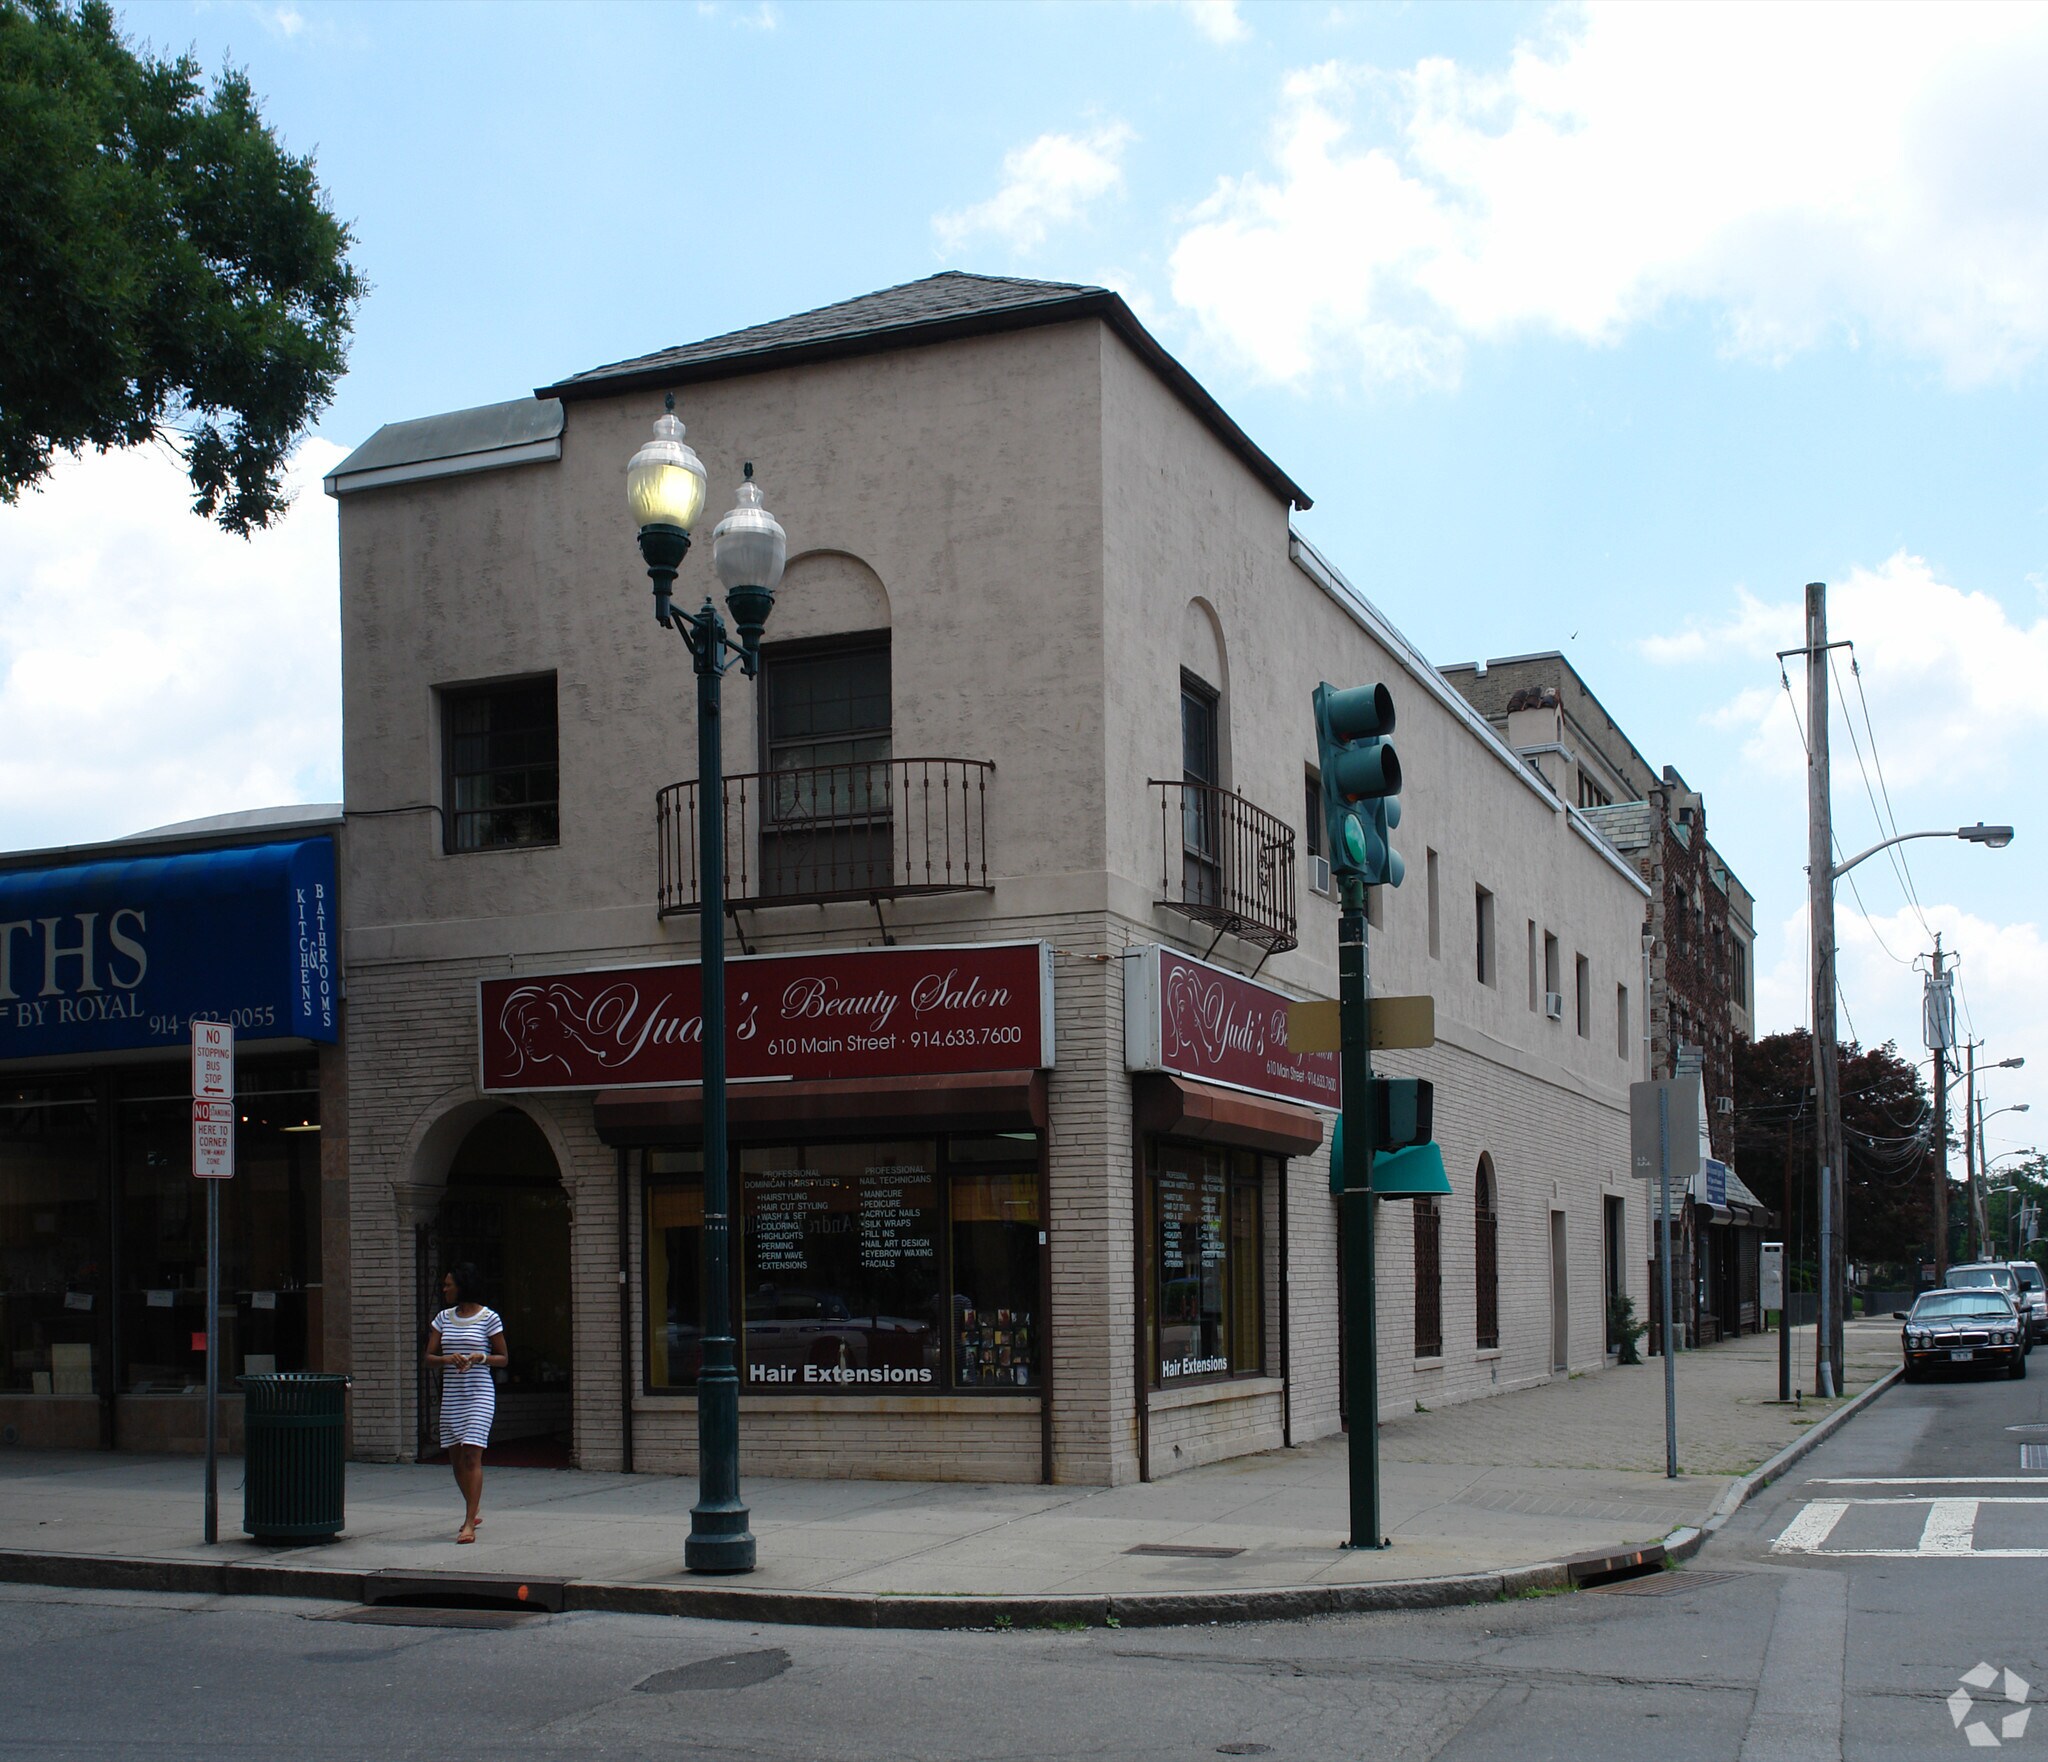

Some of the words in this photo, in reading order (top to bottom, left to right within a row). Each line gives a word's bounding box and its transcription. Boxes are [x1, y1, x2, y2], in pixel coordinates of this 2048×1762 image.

[296, 888, 312, 1016] KITCHENS
[309, 941, 319, 970] &
[315, 883, 332, 1027] BATHROOMS
[781, 976, 901, 1032] Beauty
[911, 968, 1012, 1020] Salon
[16, 1001, 49, 1027] BY
[58, 993, 145, 1023] ROYAL
[1203, 982, 1264, 1063] Yudi's
[206, 1030, 221, 1044] NO
[768, 1038, 797, 1055] 610
[801, 1037, 842, 1053] Main
[847, 1033, 897, 1051] Street
[910, 1026, 1022, 1048] 914.633.7600
[197, 1047, 230, 1059] STOPPING
[206, 1061, 220, 1071] BUS
[1277, 1062, 1290, 1078] Main
[204, 1073, 222, 1084] STOP
[195, 1104, 209, 1118] NO
[198, 1125, 217, 1136] HERE
[219, 1126, 229, 1136] TO
[199, 1137, 227, 1148] CORNER
[206, 1157, 221, 1166] ZONE
[763, 1169, 821, 1178] PROFESSIONAL
[865, 1166, 926, 1175] PROFESSIONAL
[744, 1180, 786, 1189] DOMINICAN
[859, 1177, 877, 1185] NAIL
[880, 1175, 932, 1184] TECHNICIANS
[761, 1192, 808, 1202] HAIRSTYLING
[864, 1189, 903, 1198] MANICURE
[761, 1203, 778, 1211] HAIR
[780, 1203, 795, 1211] CUT
[798, 1202, 829, 1210] STYLING
[864, 1199, 901, 1208] PEDICURE
[761, 1212, 782, 1221] WASH
[793, 1212, 808, 1220] SET
[865, 1209, 897, 1218] ACRYLIC
[899, 1209, 921, 1217] NAILS
[761, 1222, 799, 1231] COLORING
[865, 1220, 882, 1228] SILK
[884, 1219, 912, 1227] WRAPS
[761, 1231, 804, 1241] HIGHLIGHTS
[865, 1230, 880, 1238] FILL
[761, 1242, 794, 1251] PERMING
[865, 1240, 881, 1248] NAIL
[884, 1239, 899, 1247] ART
[901, 1239, 930, 1247] DESIGN
[762, 1252, 782, 1260] PERM
[784, 1251, 804, 1260] WAVE
[865, 1249, 902, 1258] EYEBROW
[904, 1248, 933, 1257] WAXING
[762, 1261, 808, 1270] EXTENSIONS
[865, 1259, 896, 1268] FACIALS
[1162, 1359, 1181, 1378] Hair
[1182, 1355, 1228, 1375] Extensions
[749, 1363, 797, 1382] Hair
[803, 1363, 933, 1382] Extensions
